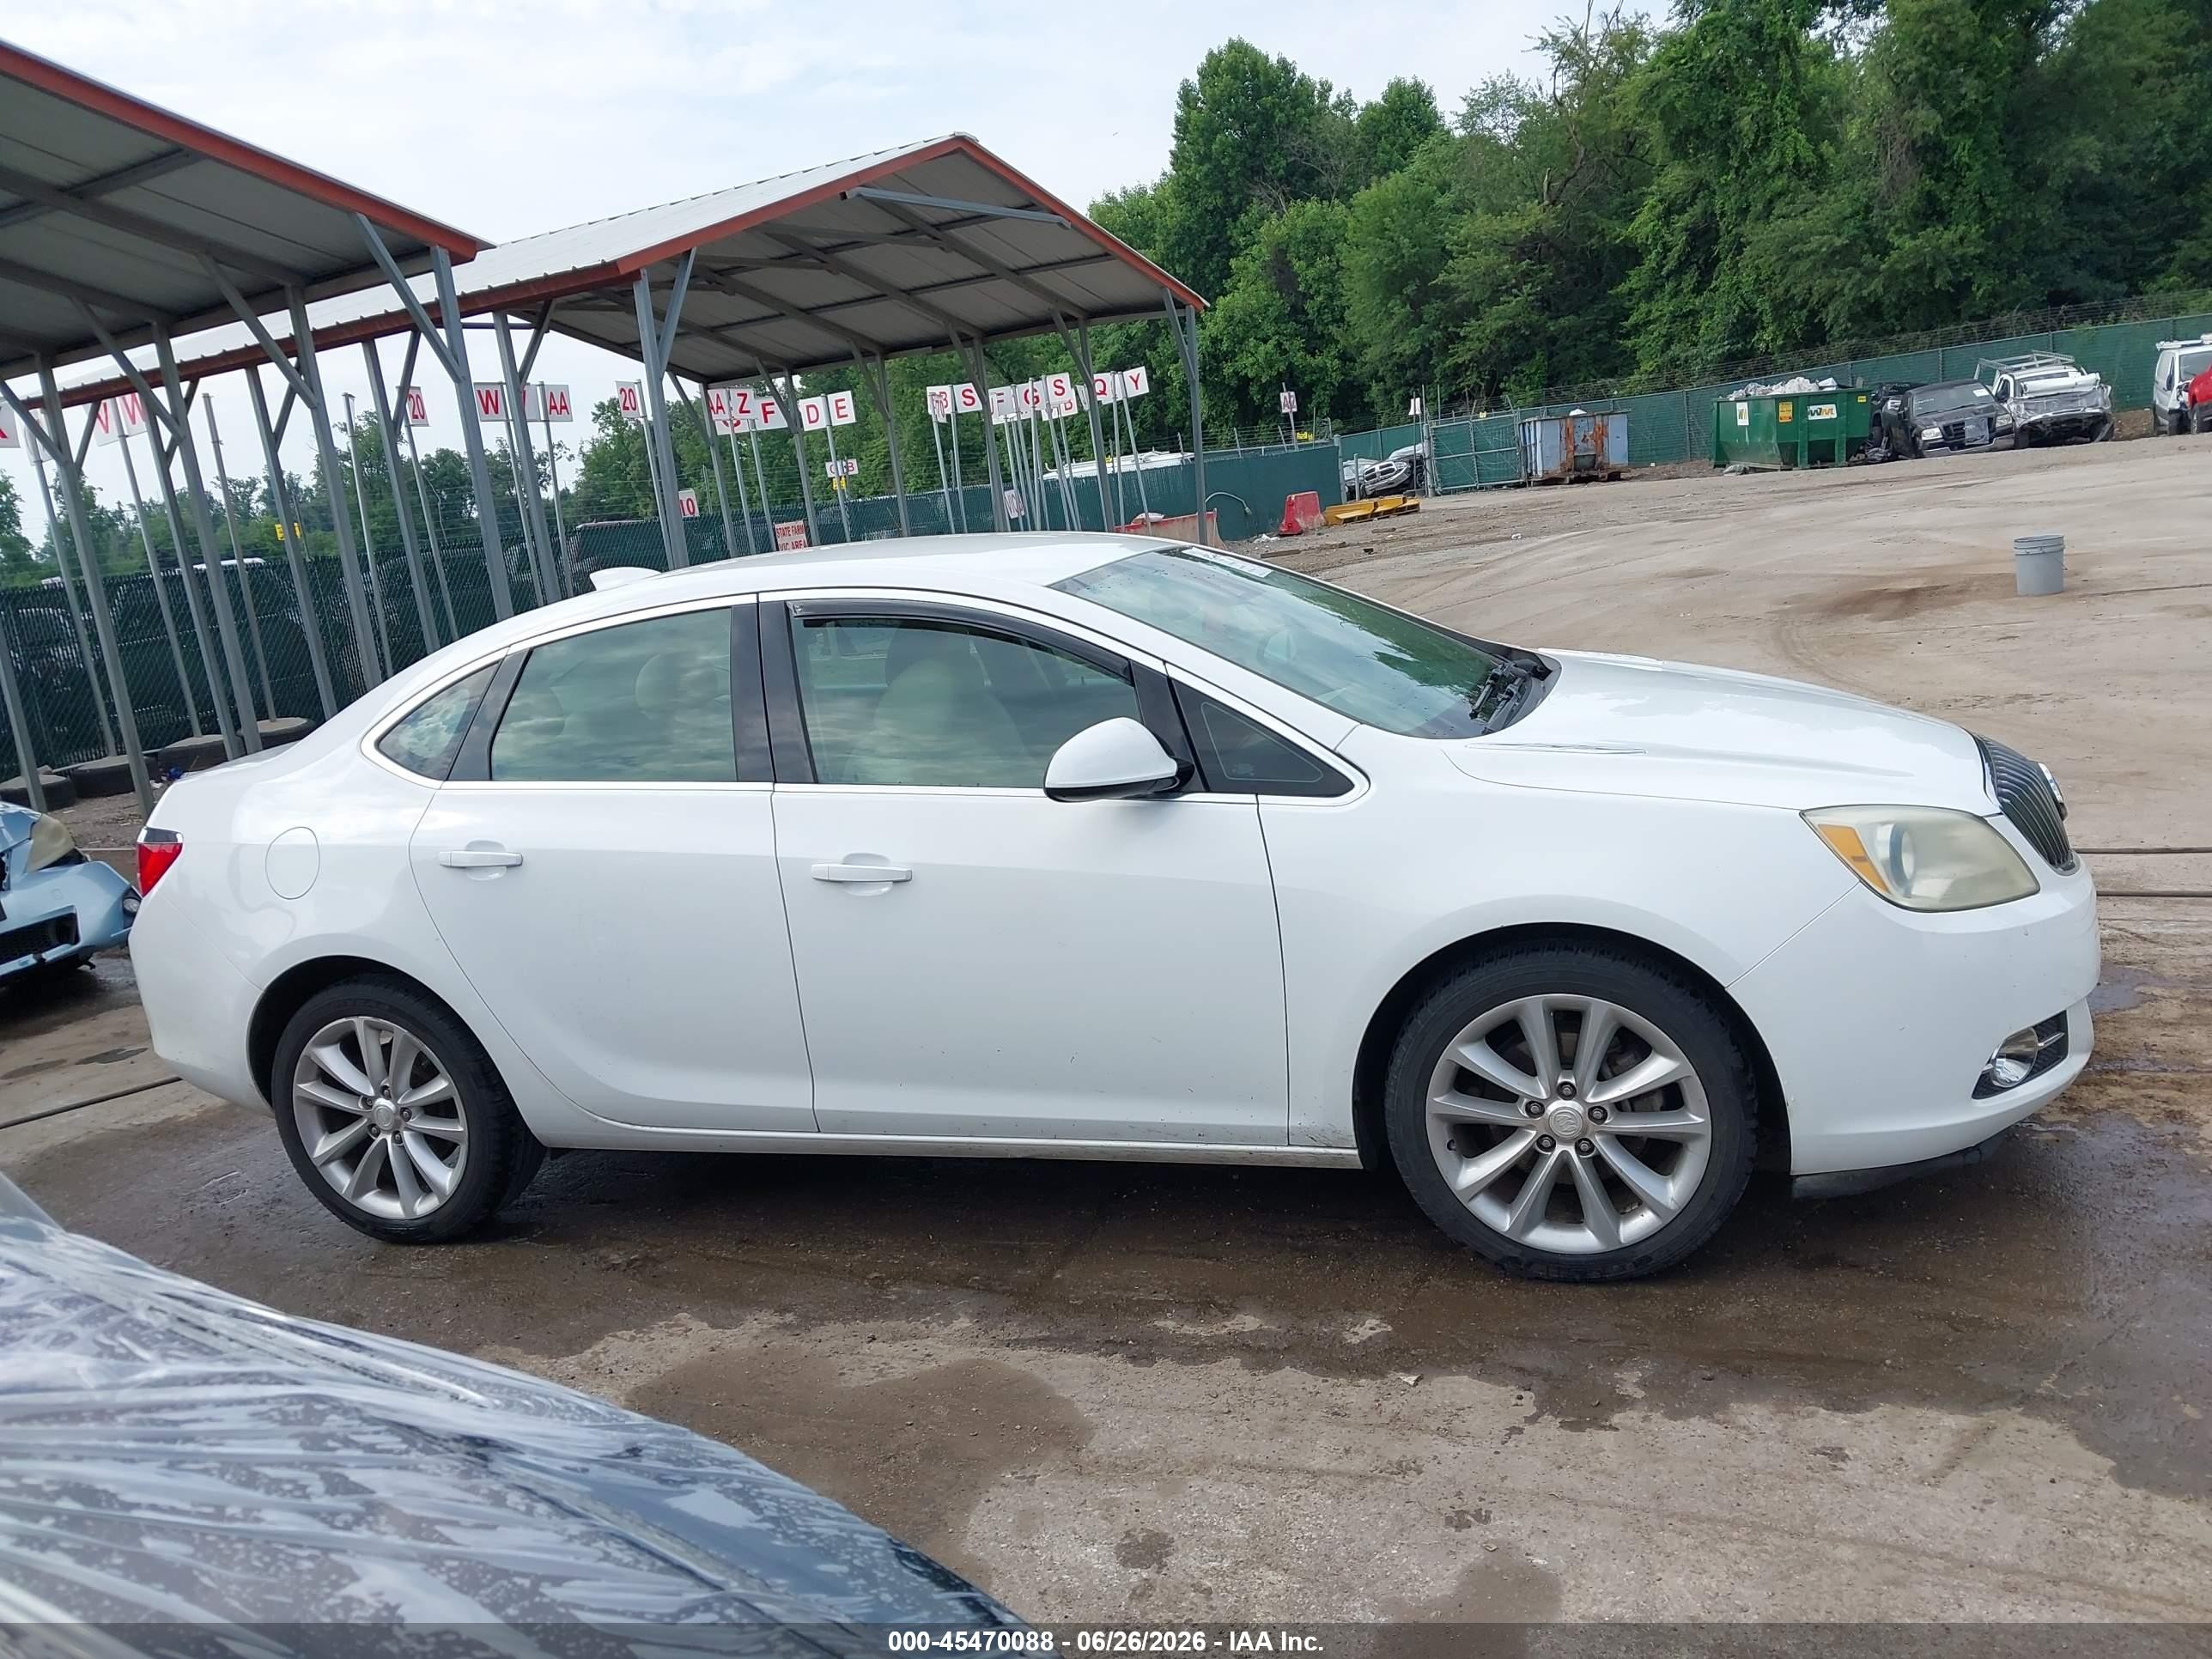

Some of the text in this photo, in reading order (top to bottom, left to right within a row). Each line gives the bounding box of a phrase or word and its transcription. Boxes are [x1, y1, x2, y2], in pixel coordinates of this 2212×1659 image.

[1052, 379, 1066, 397] S
[1093, 379, 1108, 396] Q
[1128, 373, 1141, 391] Y
[407, 393, 424, 419] 20
[476, 389, 499, 415] W
[549, 391, 570, 415] AA
[620, 387, 637, 411] 20
[737, 393, 750, 414] Z
[961, 388, 976, 406] S
[1024, 387, 1040, 405] G
[760, 402, 775, 423] F
[805, 404, 819, 424] D
[835, 398, 848, 419] E
[776, 524, 804, 538] STATE FARM
